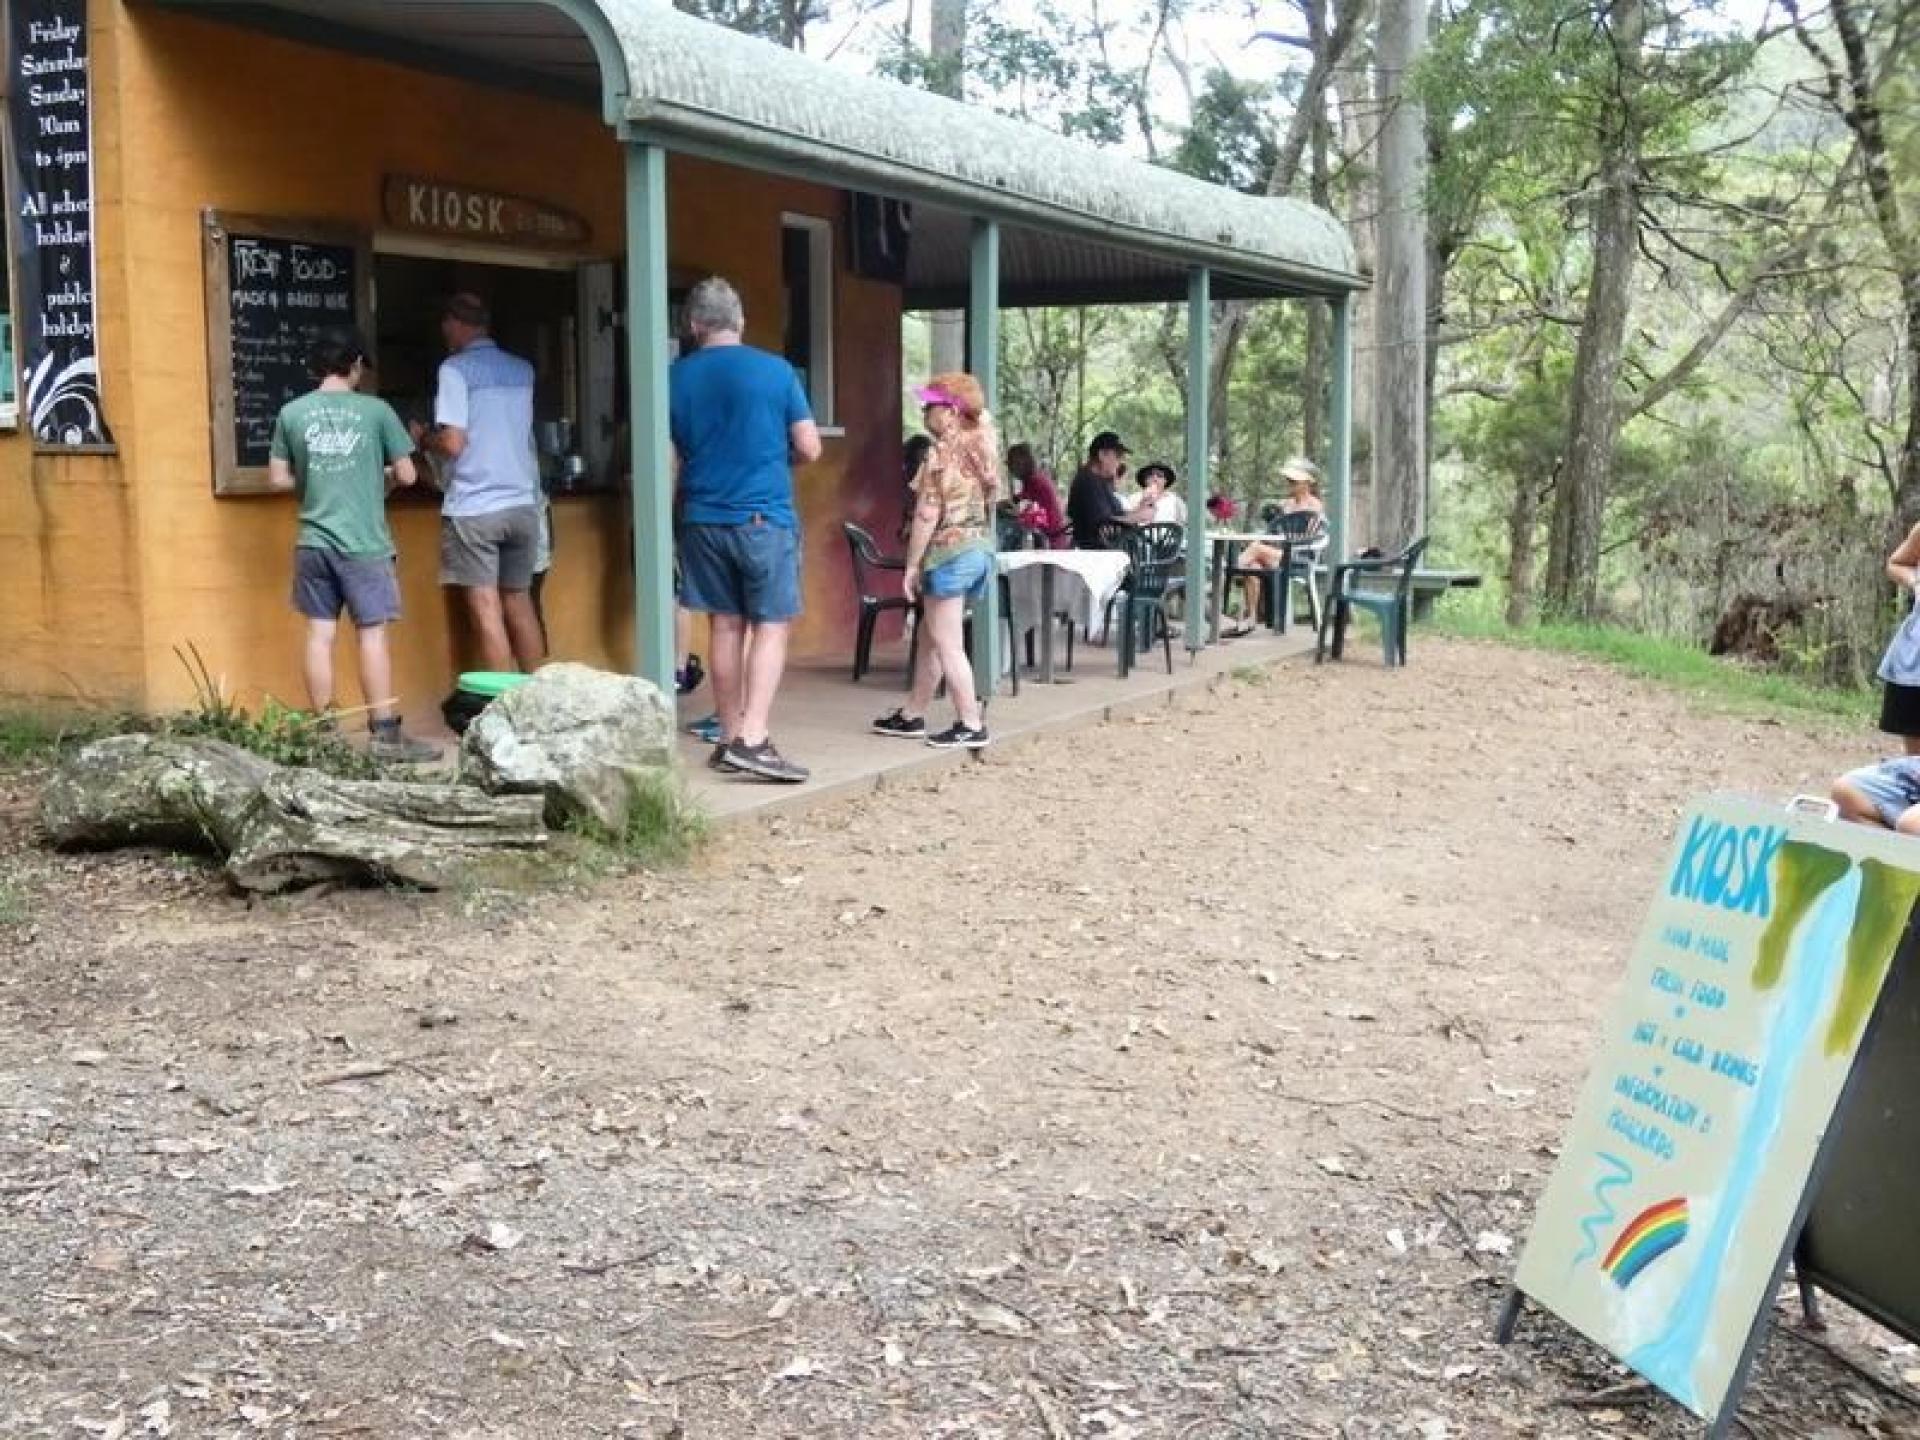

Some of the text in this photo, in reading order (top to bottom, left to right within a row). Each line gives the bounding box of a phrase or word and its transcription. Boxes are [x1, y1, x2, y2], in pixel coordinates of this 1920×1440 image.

[29, 15, 80, 43] Friday
[29, 78, 85, 106] Sunday
[35, 150, 51, 167] to
[20, 192, 49, 217] All
[408, 184, 504, 233] KIOSK
[1670, 814, 1788, 918] KIOSK
